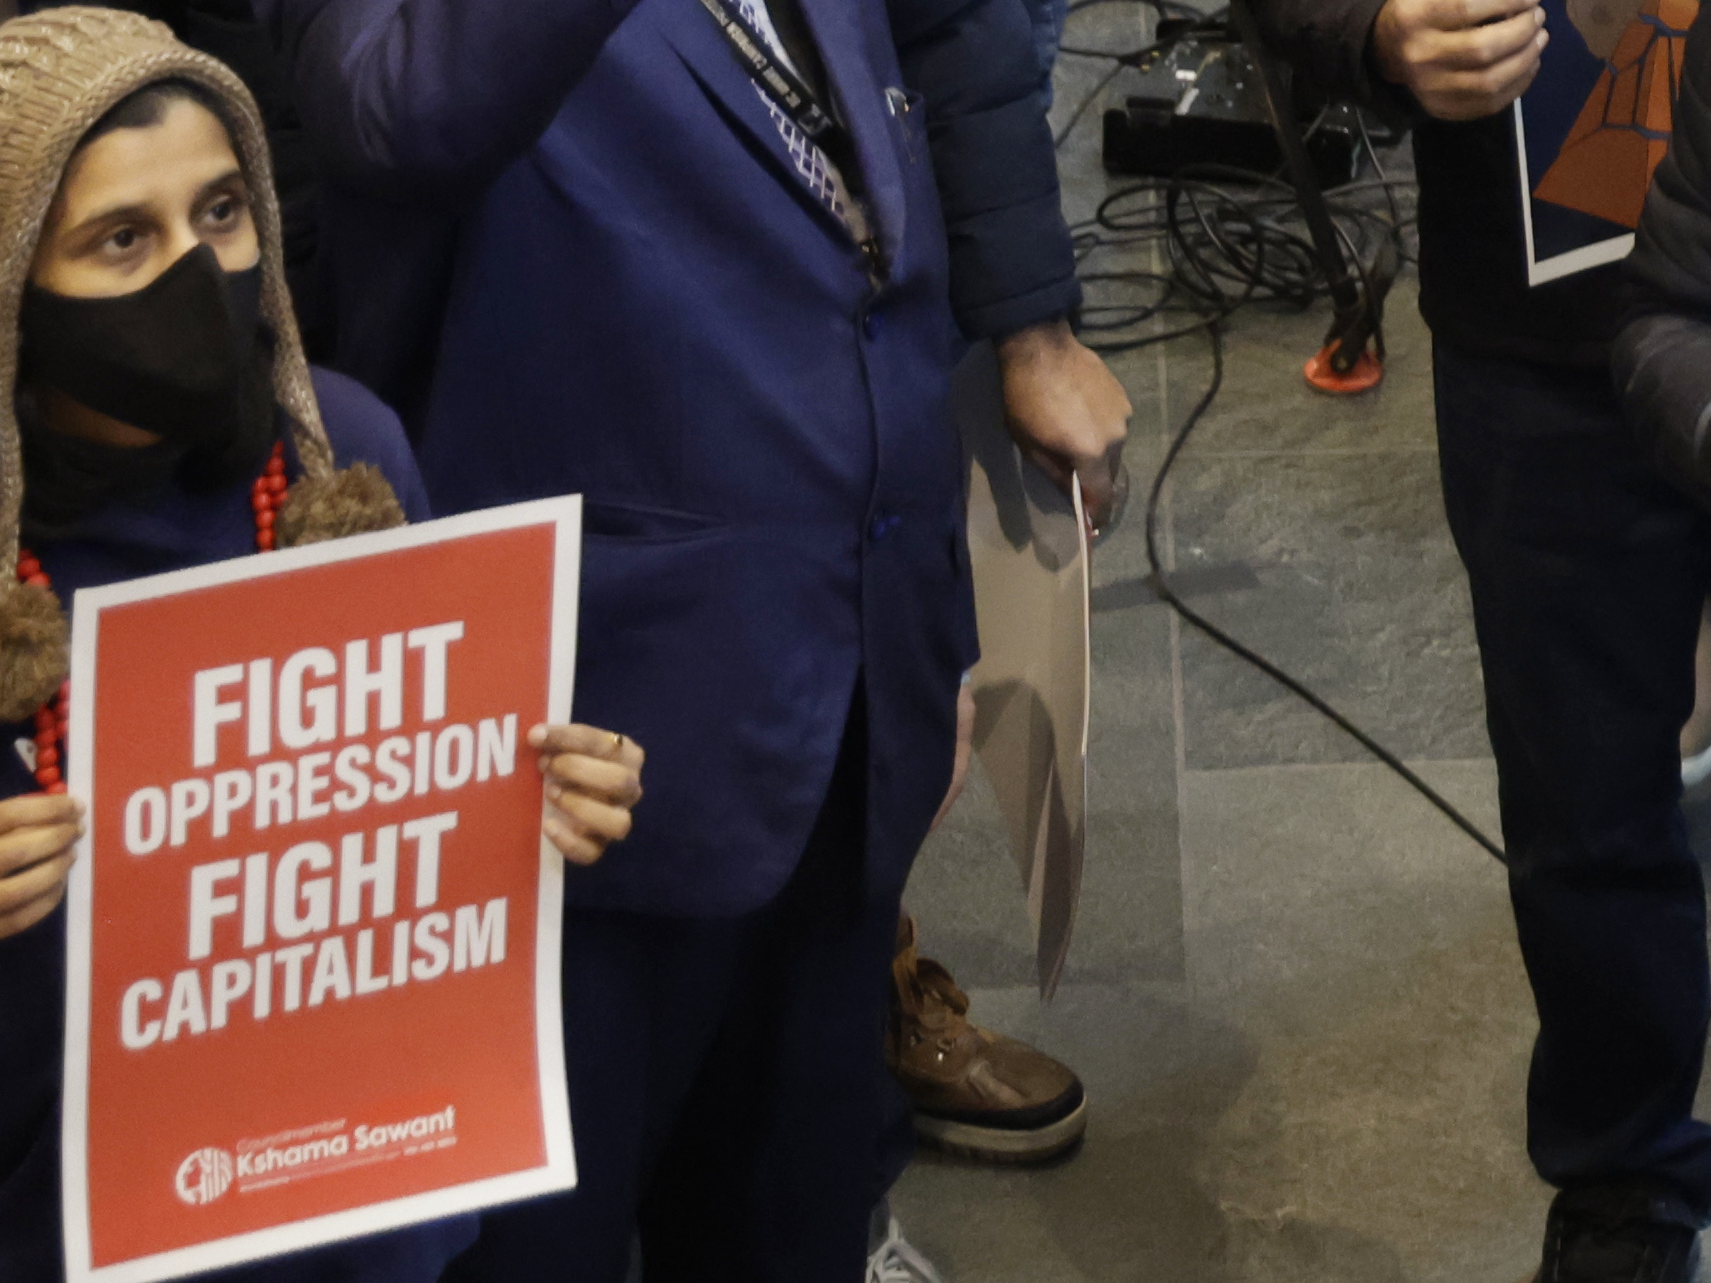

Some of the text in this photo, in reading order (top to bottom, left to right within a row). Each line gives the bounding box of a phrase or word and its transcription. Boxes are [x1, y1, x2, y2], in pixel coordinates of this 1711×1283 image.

[191, 620, 465, 768] FIGHT
[123, 713, 519, 858] OPPRESSION
[187, 811, 459, 963] FIGHT
[120, 896, 508, 1052] CAPITALISM
[236, 1104, 456, 1178] Kshama Sawant
